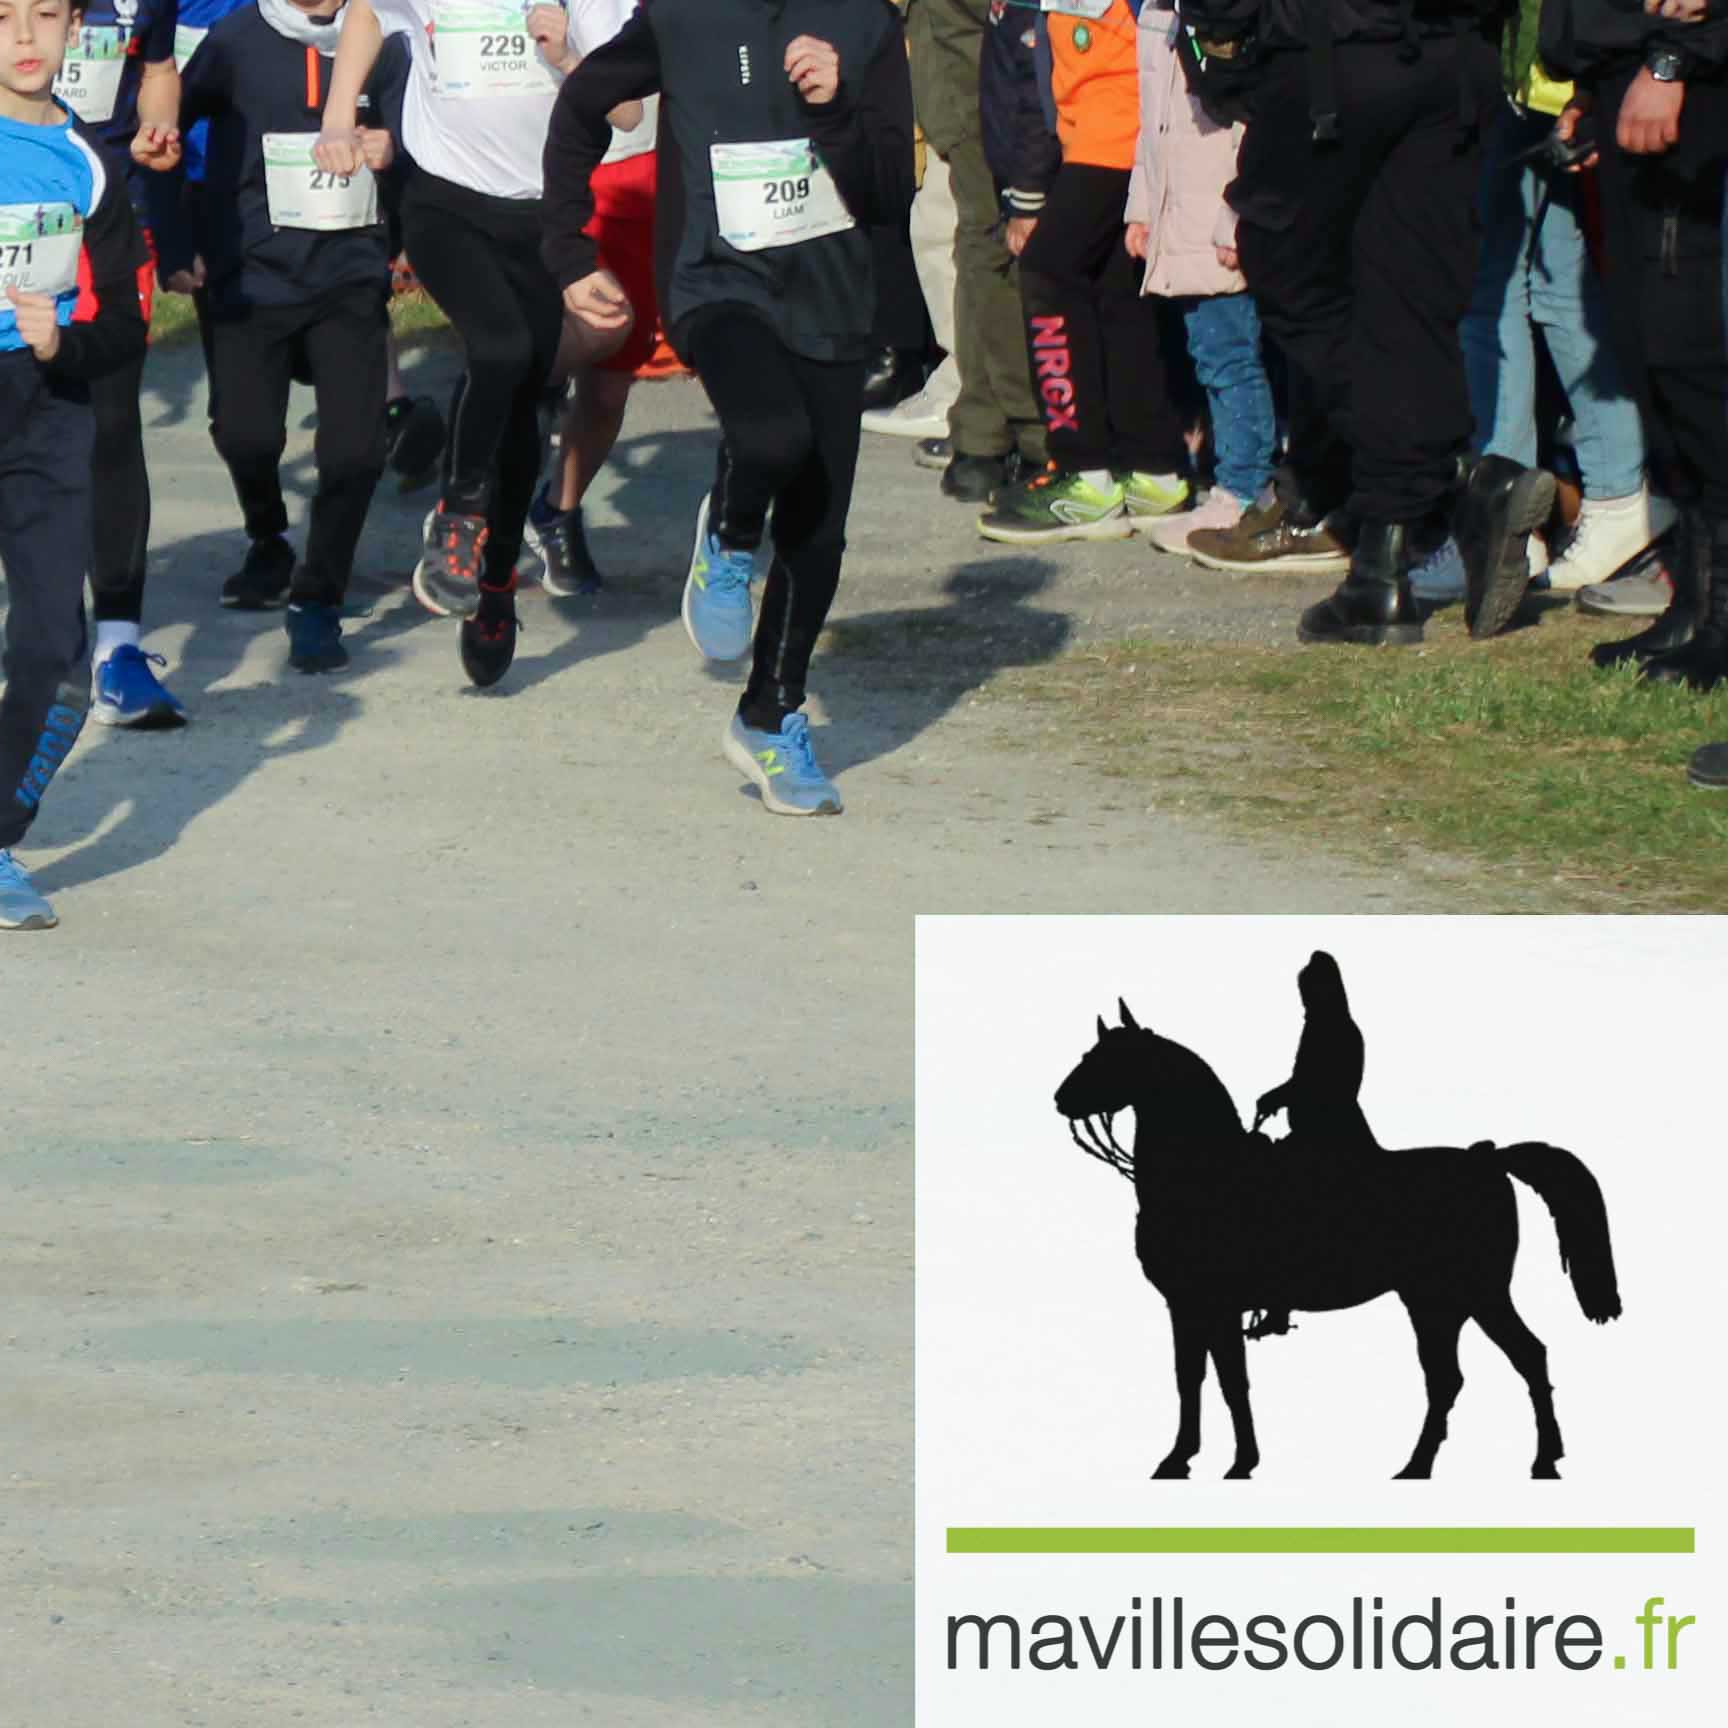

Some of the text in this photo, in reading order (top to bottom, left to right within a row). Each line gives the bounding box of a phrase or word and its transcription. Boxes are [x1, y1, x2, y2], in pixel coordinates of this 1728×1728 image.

[479, 35, 526, 57] 229
[478, 59, 529, 73] VICTOR
[763, 178, 811, 204] 209
[773, 205, 805, 221] LIAM
[1029, 314, 1081, 431] NRGX
